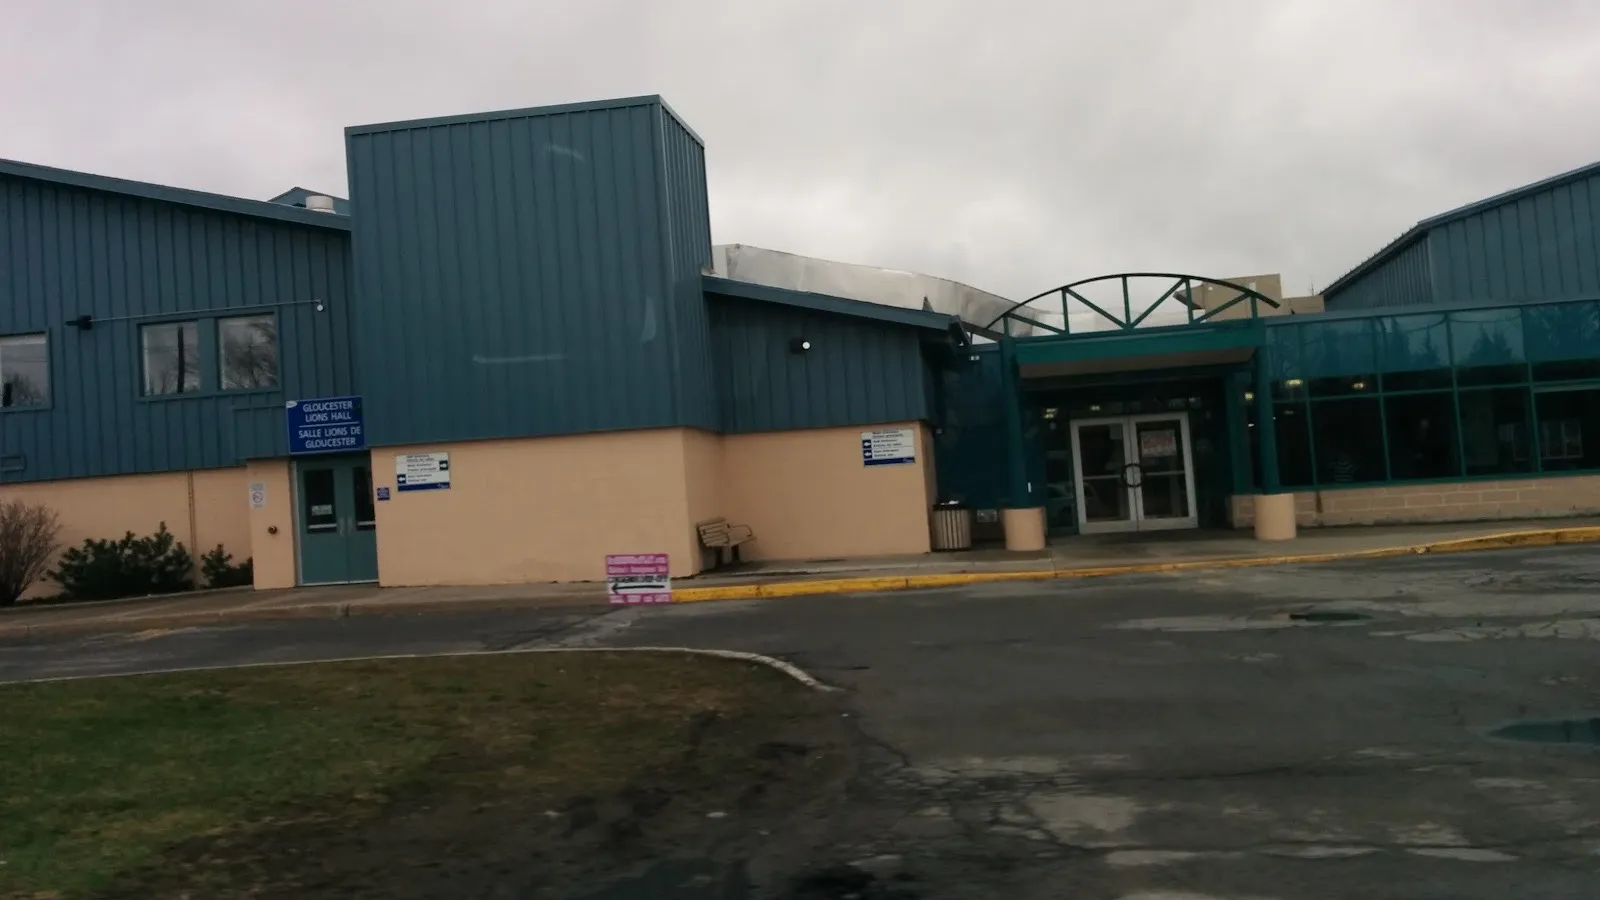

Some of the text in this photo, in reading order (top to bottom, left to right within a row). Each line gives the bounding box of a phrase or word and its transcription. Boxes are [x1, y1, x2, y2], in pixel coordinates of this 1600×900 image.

[303, 401, 353, 412] GLOUCESTER
[305, 412, 352, 422] LIONS HALL
[298, 426, 361, 439] SALLE LIONS DE
[305, 438, 356, 449] GLOUCESTER
